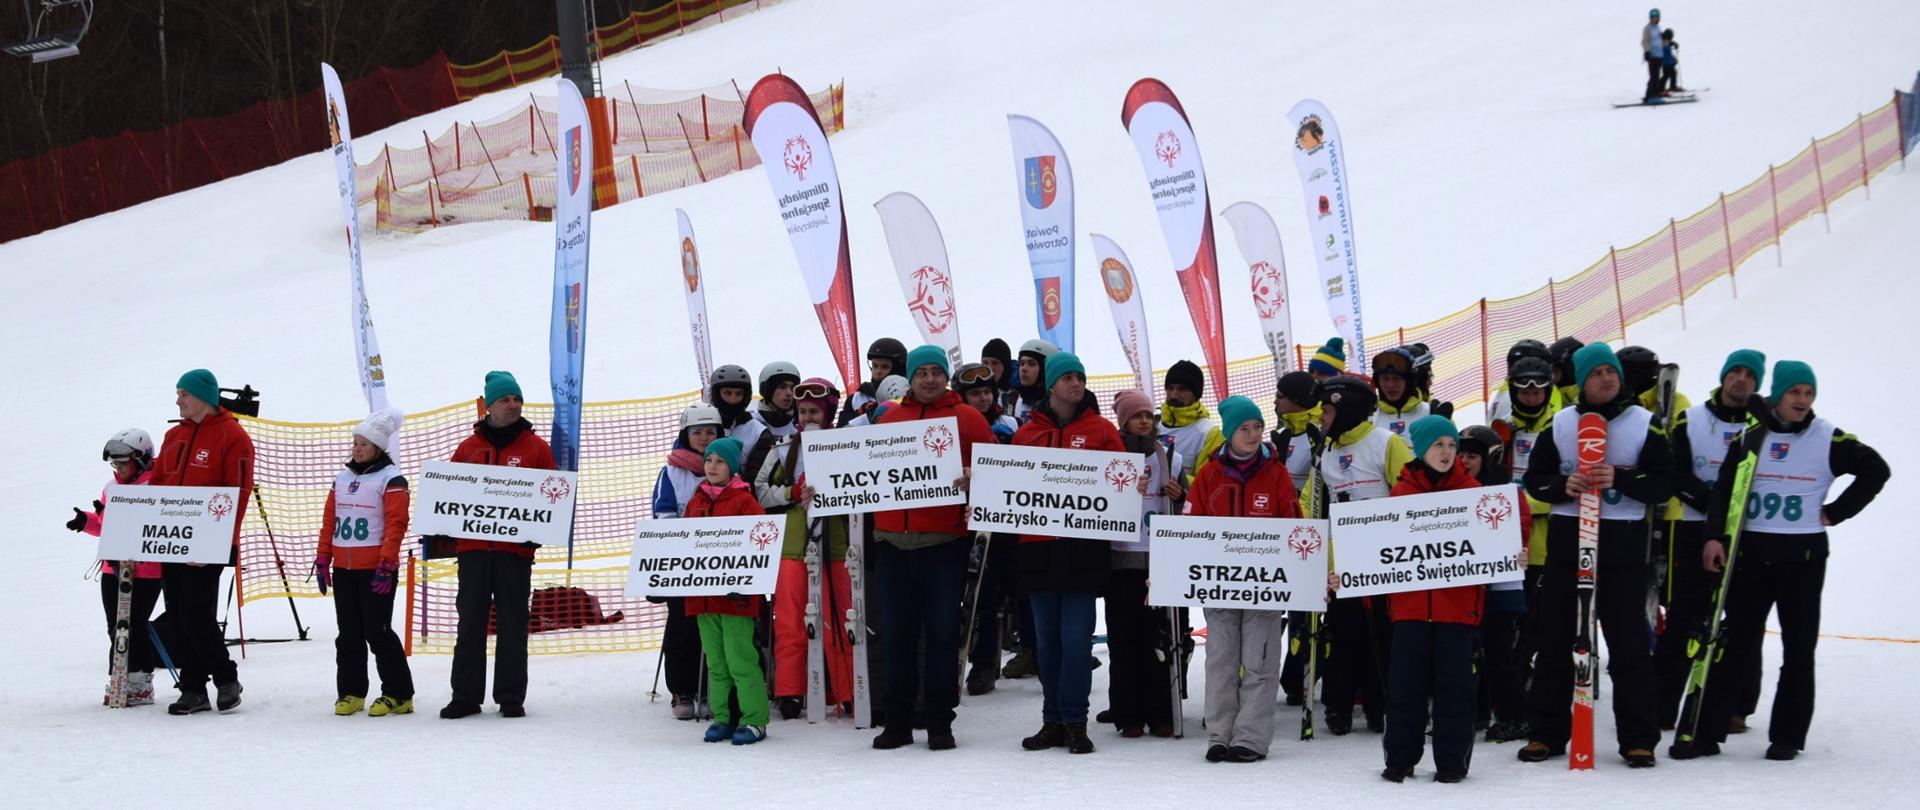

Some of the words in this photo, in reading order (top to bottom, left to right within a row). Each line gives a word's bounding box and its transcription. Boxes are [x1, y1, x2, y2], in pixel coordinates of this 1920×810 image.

[808, 440, 860, 453] Olimpiady
[865, 435, 917, 448] Specjalne
[868, 448, 919, 460] Świętokrzyskie
[977, 456, 1036, 470] Olimpiady
[1040, 460, 1098, 473] Specjalne
[424, 471, 479, 484] Olimpiady
[482, 476, 535, 487] Specjalne
[829, 470, 881, 489] TACY
[888, 464, 938, 484] SAMI
[1042, 473, 1098, 486] Świętokrzyskie
[111, 495, 157, 506] Olimpiady
[159, 497, 204, 507] Specjalne
[483, 487, 533, 498] Świętokrzyskie
[813, 489, 880, 509] Skarżysko
[894, 484, 960, 501] Kamienna
[1003, 490, 1108, 512] TORNADO
[433, 501, 553, 524] KRYSZTAŁKI
[1337, 512, 1400, 526] Olimpiady
[1405, 505, 1468, 520] Specjalne
[1746, 492, 1803, 522] 098
[462, 519, 519, 536] Kielce
[973, 506, 1048, 528] Skarżysko
[1064, 513, 1136, 533] Kamienna
[1409, 519, 1470, 533] Świętokrzyskie
[1578, 493, 1600, 548] HERO
[142, 524, 193, 539] MAAG
[639, 529, 690, 540] Olimpiady
[693, 528, 745, 538] Specjalne
[1156, 529, 1216, 541] Olimpiady
[1221, 530, 1281, 541] Specjalne
[141, 540, 190, 555] Kielce
[694, 540, 743, 549] Świętokrzyskie
[1223, 543, 1281, 555] Świętokrzyskie
[1379, 539, 1476, 565] SZANSA
[638, 554, 770, 572] NIEPOKONANI
[1341, 567, 1413, 588] Ostrowiec
[1416, 554, 1518, 583] Świętokrzyski
[648, 572, 754, 588] Sandomierz
[1188, 564, 1288, 583] STRZAŁA
[1183, 583, 1292, 605] Jędrzejów
